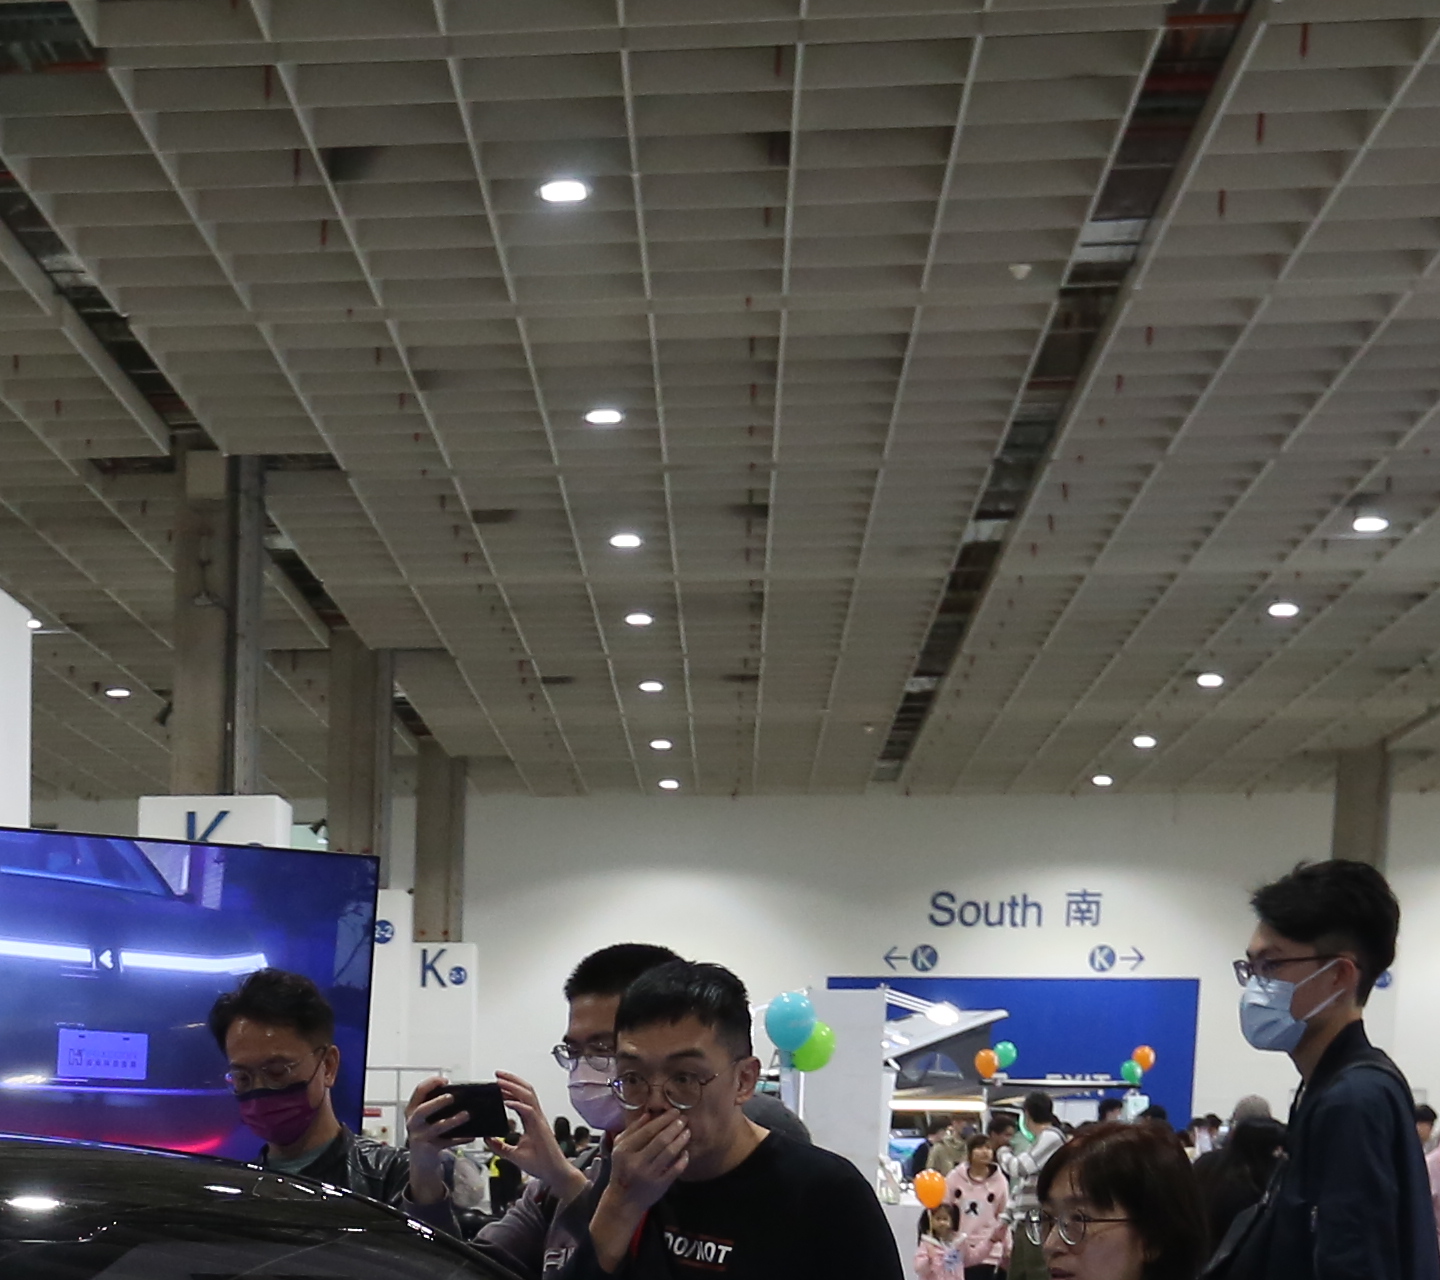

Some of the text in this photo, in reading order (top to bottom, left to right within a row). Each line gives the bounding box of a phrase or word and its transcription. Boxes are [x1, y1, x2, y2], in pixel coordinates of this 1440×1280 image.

[928, 888, 1103, 928] South 南
[421, 948, 447, 988] K
[916, 946, 933, 970] K
[1094, 947, 1110, 970] K
